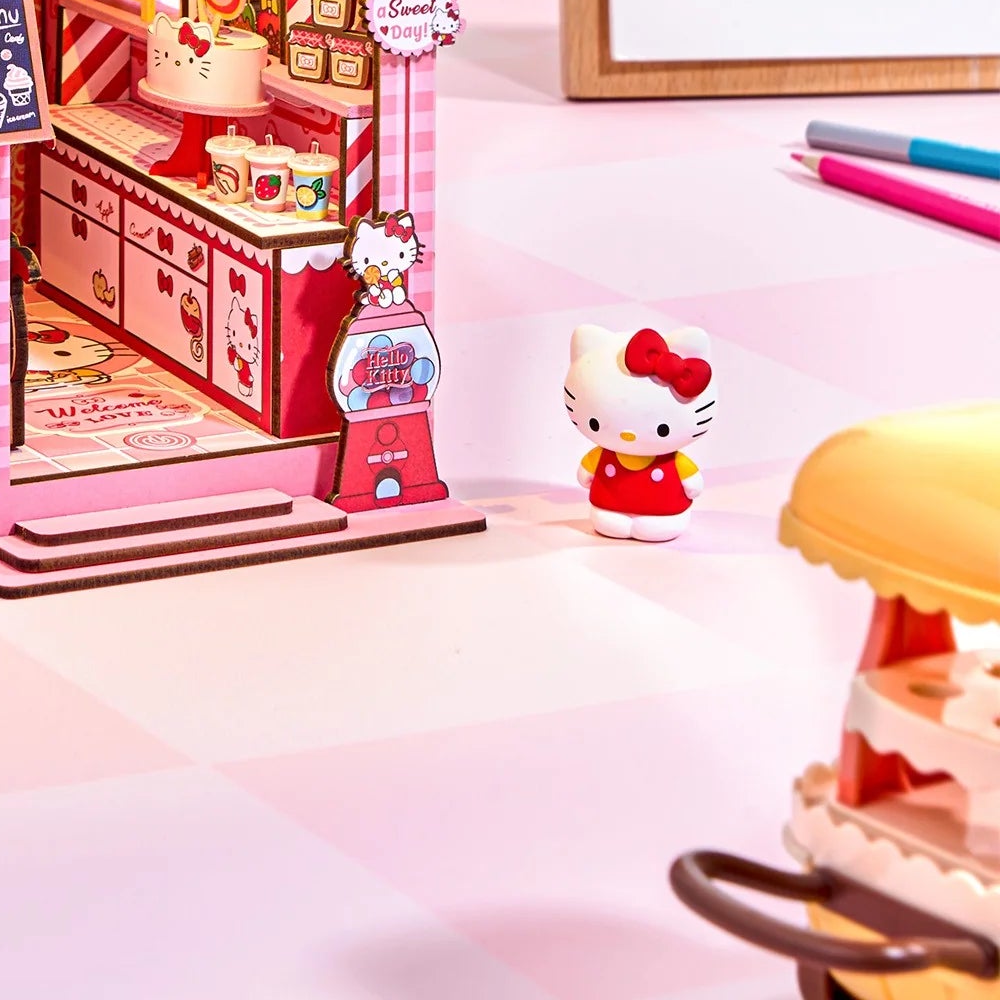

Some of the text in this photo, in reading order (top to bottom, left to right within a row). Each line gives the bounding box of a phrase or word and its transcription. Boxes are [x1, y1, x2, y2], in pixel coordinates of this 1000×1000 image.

[377, 6, 386, 18] a
[390, 22, 428, 42] Day!
[366, 350, 408, 369] Hello
[366, 368, 410, 386] Kitty
[34, 400, 163, 418] Welcome
